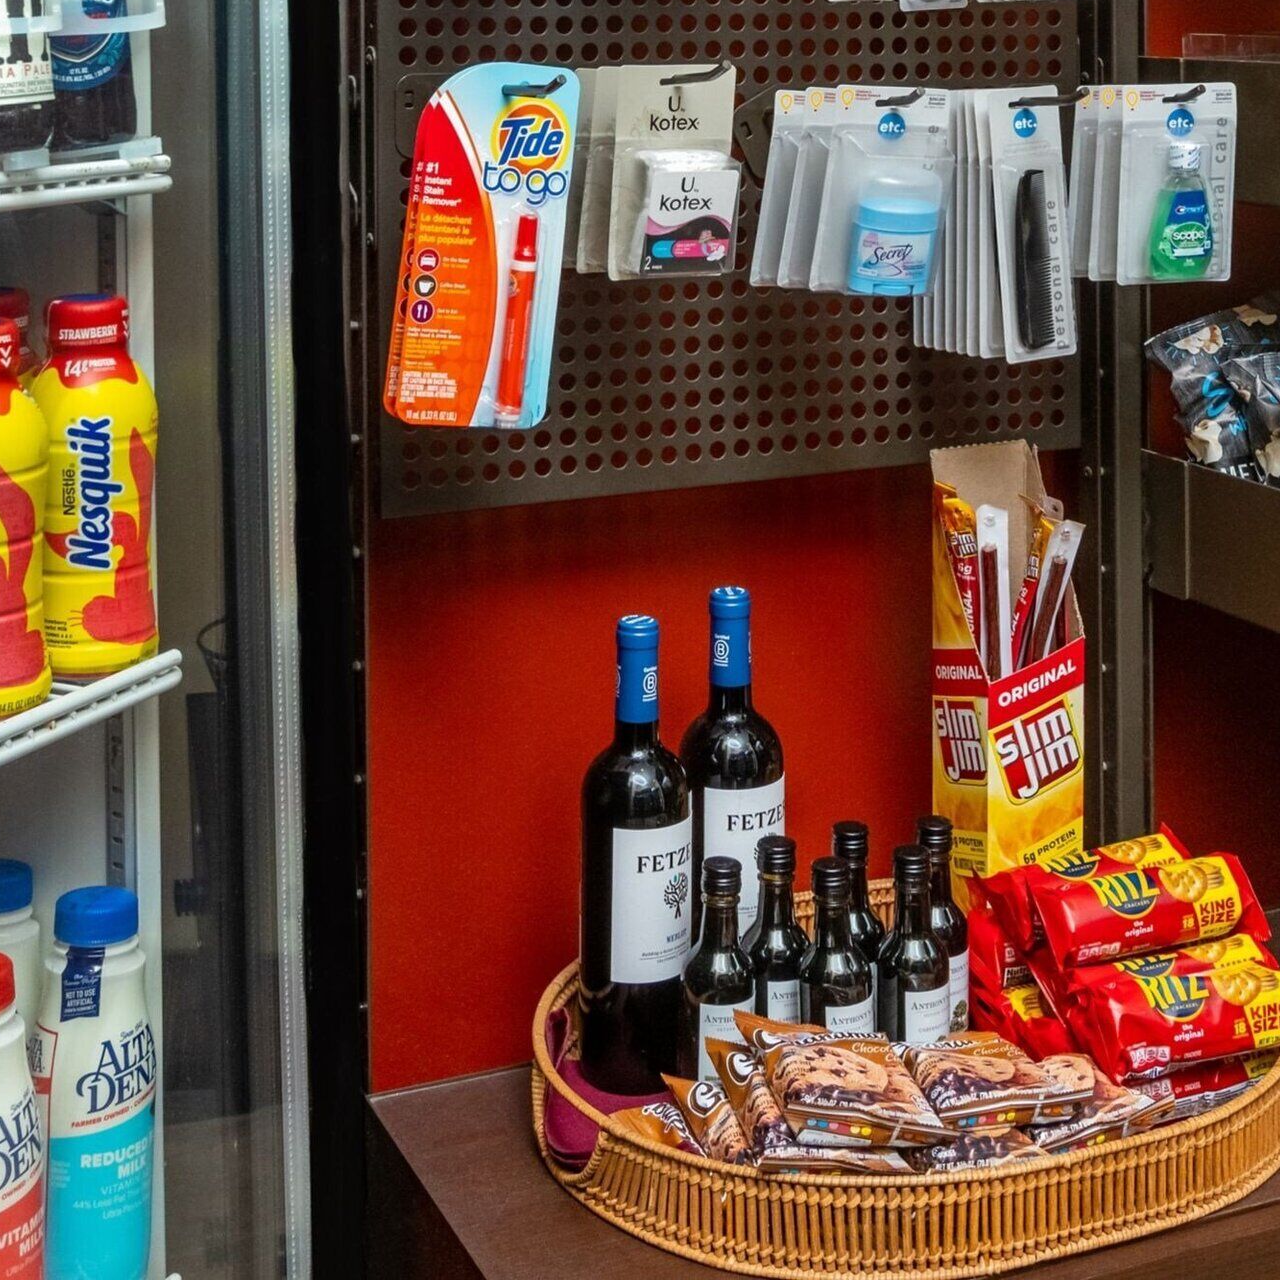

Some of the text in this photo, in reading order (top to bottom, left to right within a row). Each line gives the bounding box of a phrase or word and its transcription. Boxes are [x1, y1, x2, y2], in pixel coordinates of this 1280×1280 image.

[650, 114, 699, 131] kotex
[879, 122, 905, 134] etc.
[1014, 118, 1037, 130] etc.
[1168, 117, 1194, 129] etc.
[498, 119, 563, 165] Tide
[426, 163, 438, 174] #1
[425, 176, 451, 186] Instant
[483, 162, 567, 205] to go
[424, 186, 443, 195] Stain
[660, 196, 712, 211] kotex
[1047, 200, 1056, 249] care
[870, 245, 914, 267] Secret
[59, 326, 117, 340] STRAWBERRY
[64, 468, 75, 515] Nestlé
[70, 418, 123, 571] Nesquik
[936, 664, 982, 679] ORIGINAL
[998, 659, 1076, 707] ORIGINAL
[1023, 829, 1075, 864] 6g PROTEIN
[1088, 869, 1160, 908] RITZ
[1200, 898, 1235, 915] KING
[1182, 918, 1194, 929] 18
[1200, 910, 1235, 926] SIZE
[1125, 925, 1153, 937] original
[1137, 976, 1209, 1010] RITZ
[1174, 1030, 1203, 1041] original
[1234, 1023, 1246, 1034] 18
[118, 1156, 146, 1180] MILK
